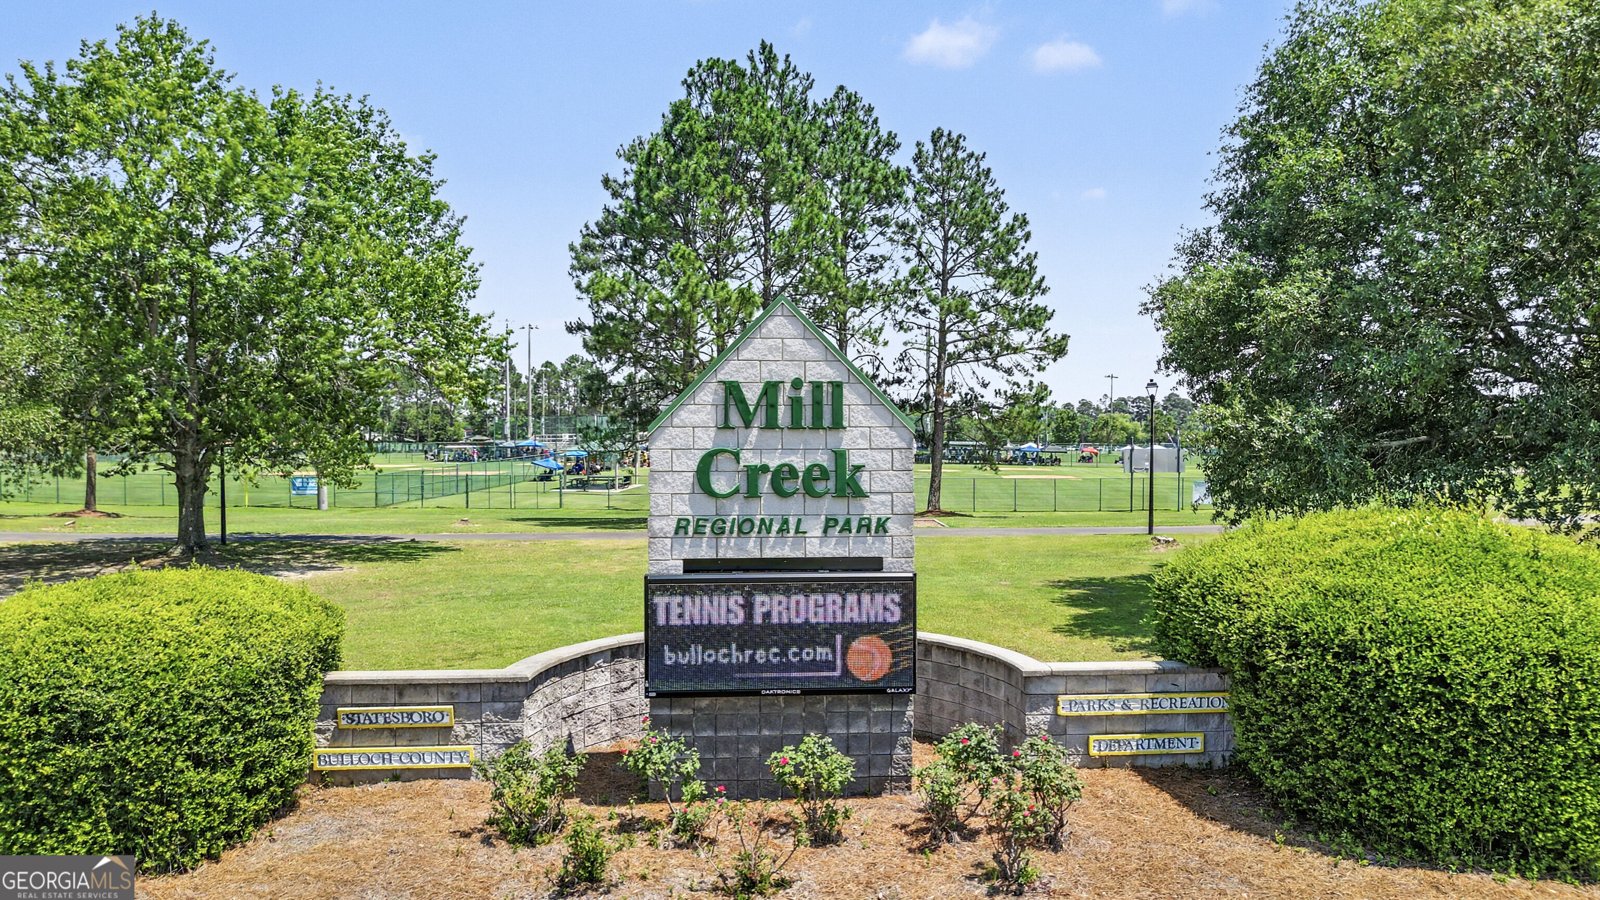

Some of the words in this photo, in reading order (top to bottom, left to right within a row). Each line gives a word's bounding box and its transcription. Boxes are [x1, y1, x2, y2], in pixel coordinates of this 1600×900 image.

[718, 377, 847, 429] Mill
[696, 447, 870, 499] Creek
[674, 517, 808, 536] REGIONAL
[822, 516, 891, 534] PARK
[653, 594, 746, 626] TENNIS
[752, 592, 901, 624] PROGRAMS
[663, 643, 833, 666] bullochrec.com
[1069, 699, 1116, 712] PARKS
[1121, 698, 1132, 711] &
[345, 711, 445, 725] STATESBORO
[1097, 737, 1196, 752] DEPARTMENT
[318, 753, 394, 767] BULLOCH
[400, 751, 467, 765] COUNTY
